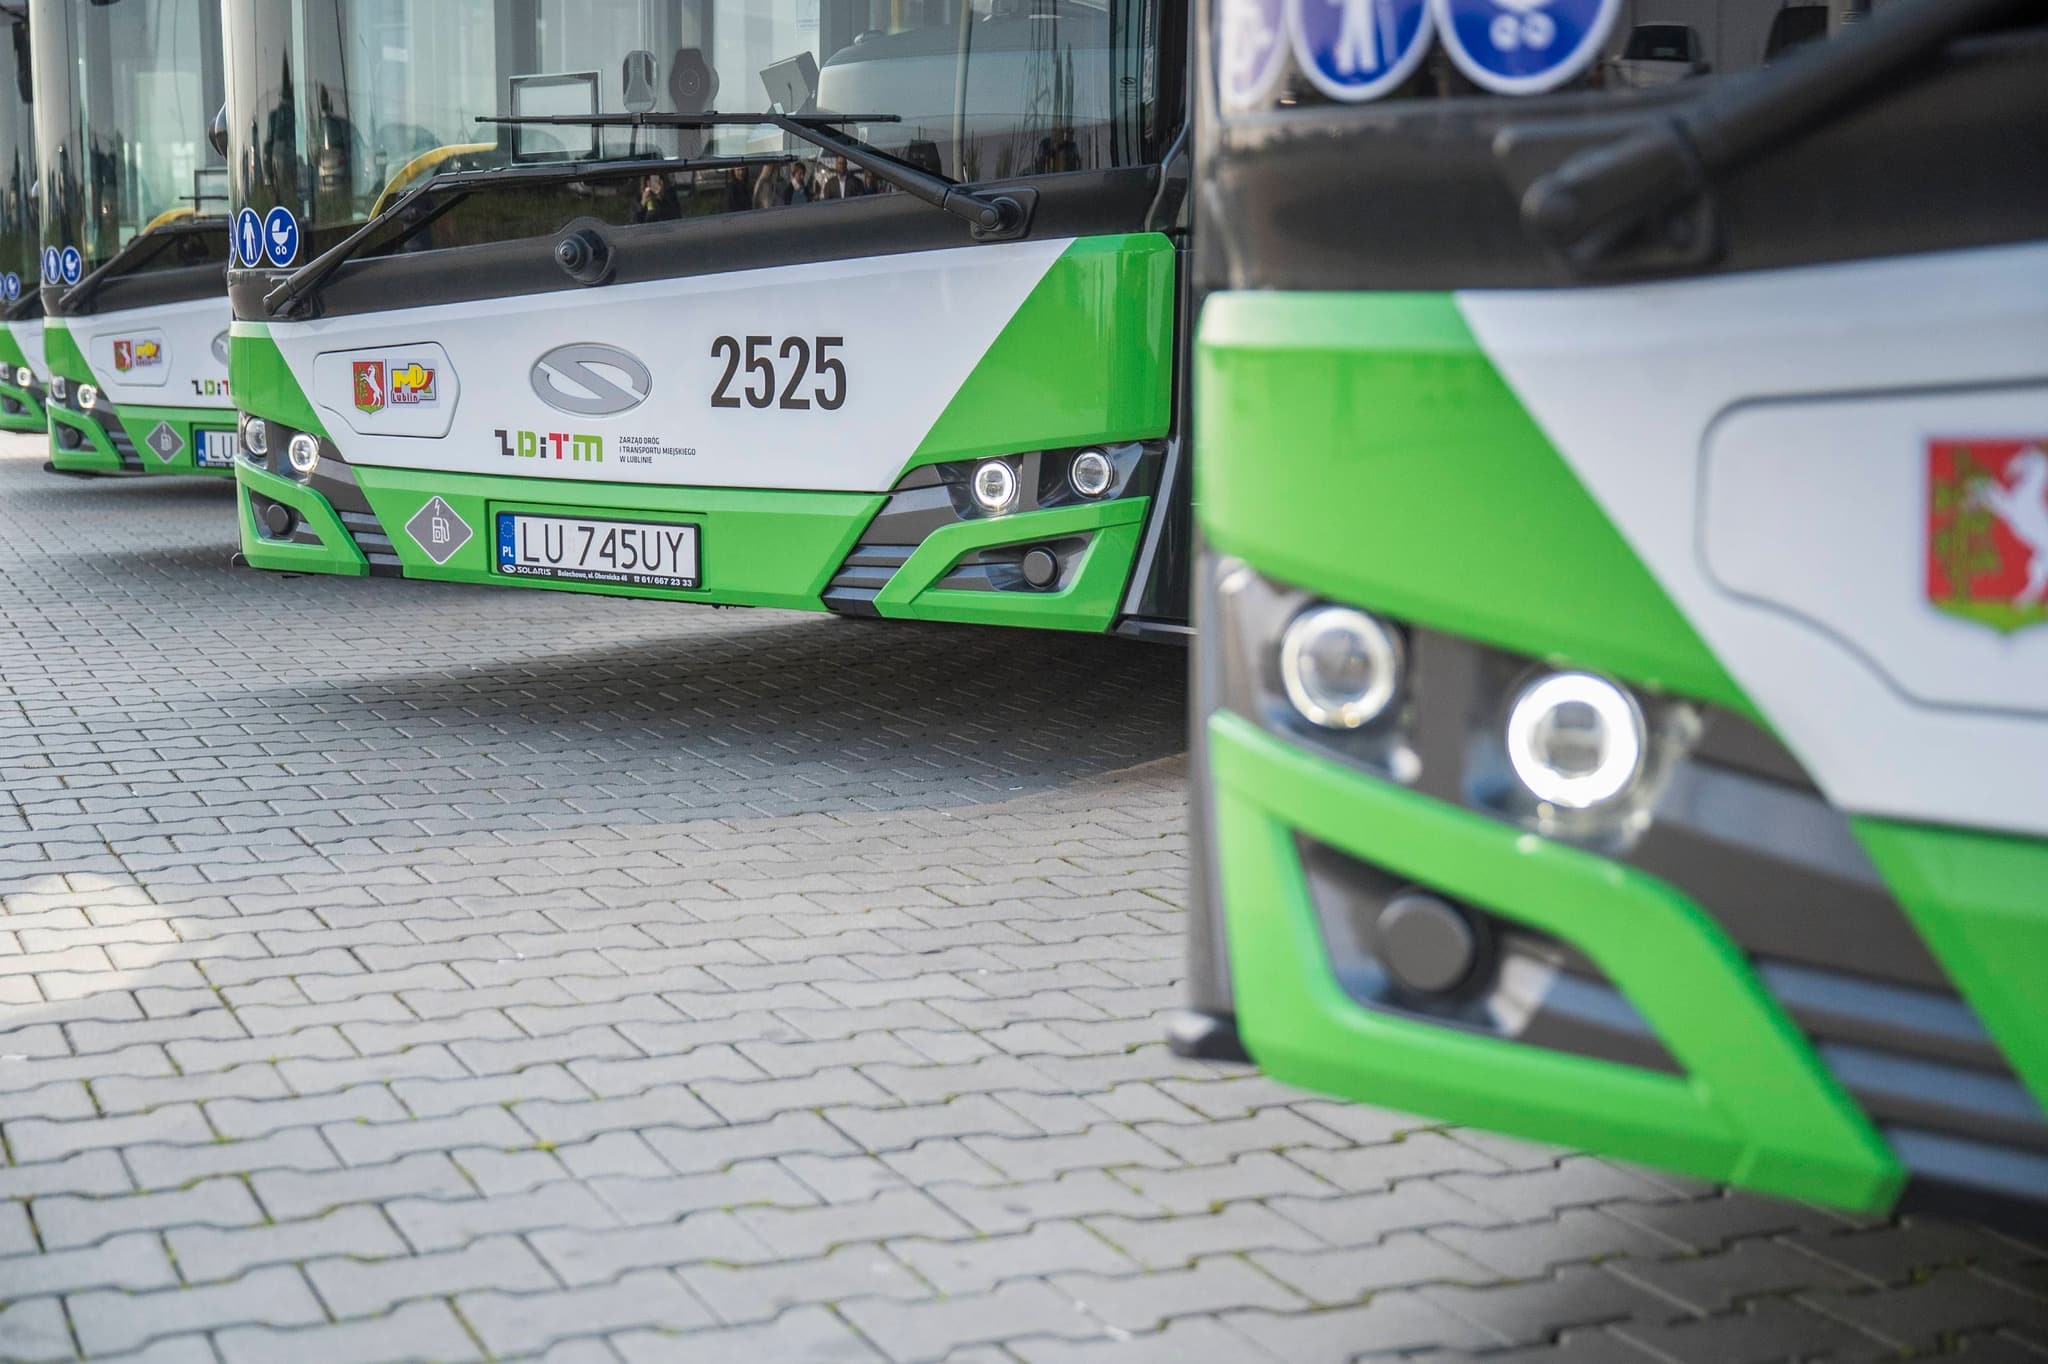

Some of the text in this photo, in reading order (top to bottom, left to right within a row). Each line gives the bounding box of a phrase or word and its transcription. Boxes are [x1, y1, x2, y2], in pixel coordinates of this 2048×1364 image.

[711, 335, 847, 410] 2525
[392, 393, 418, 402] Lublin
[619, 436, 660, 445] ZARZĄD DRÓG
[210, 435, 233, 459] LU
[623, 446, 661, 454] TRANSPORTU
[662, 447, 696, 456] MIEJSKIEGO
[619, 455, 653, 464] W LUBLINIE
[502, 545, 514, 557] PL
[523, 522, 684, 573] LU 745UY
[516, 566, 551, 576] SOLARIS
[670, 578, 680, 586] 23
[682, 579, 692, 587] 33
